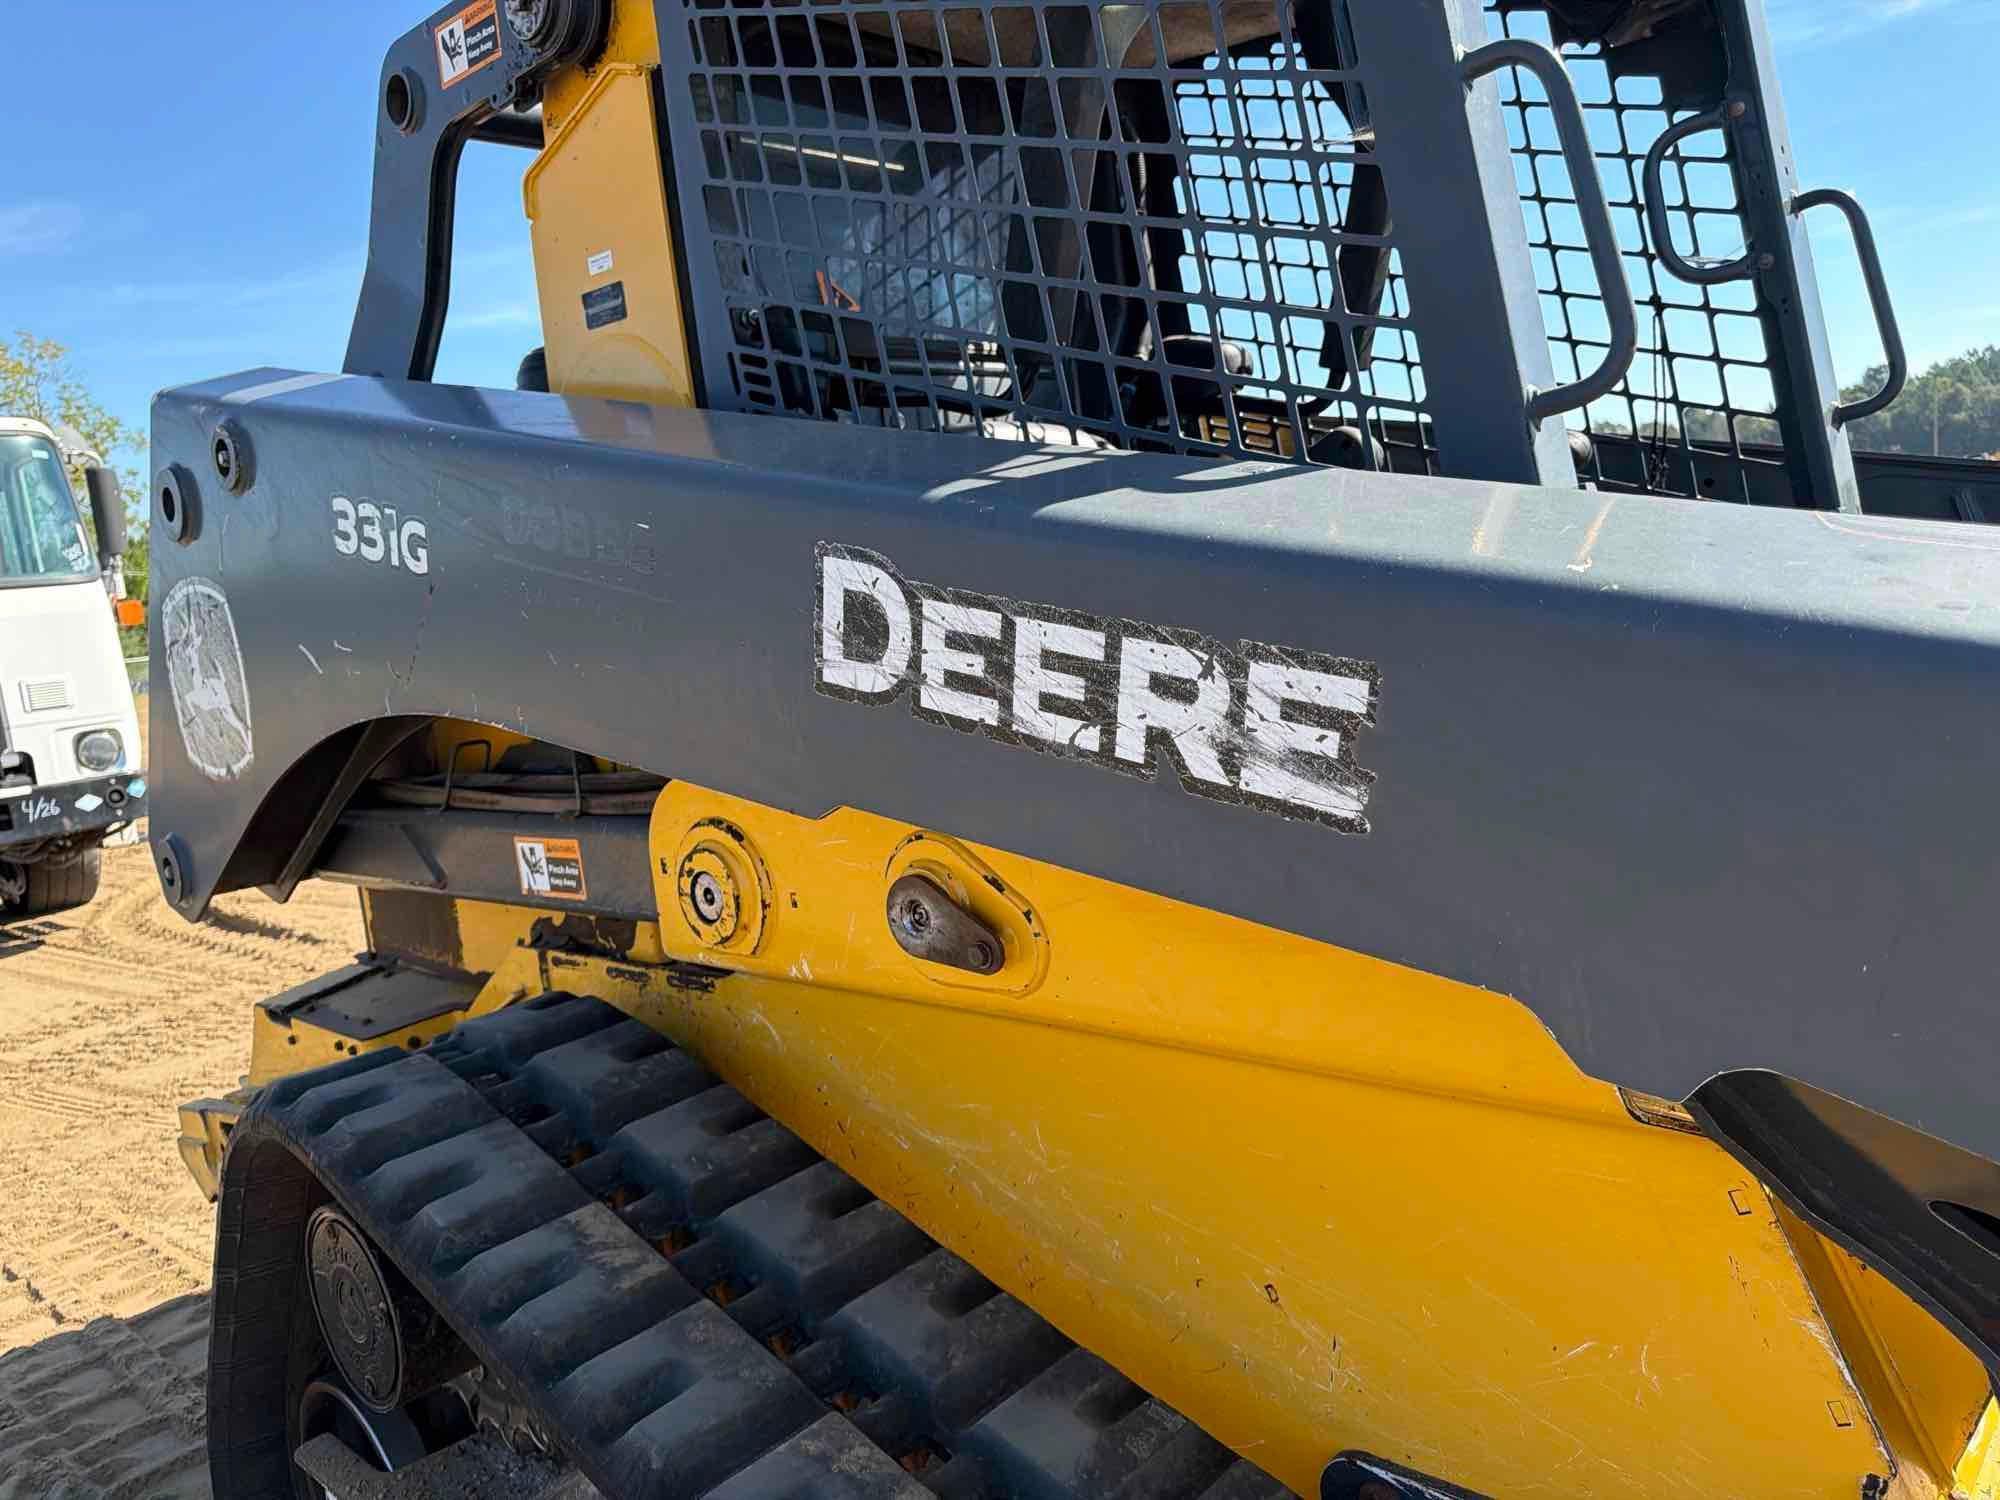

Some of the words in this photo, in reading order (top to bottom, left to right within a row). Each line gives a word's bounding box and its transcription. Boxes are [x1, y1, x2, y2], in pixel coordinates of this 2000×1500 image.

[331, 496, 430, 575] 331G
[822, 555, 1371, 820] DEERE
[20, 796, 62, 823] 4/26
